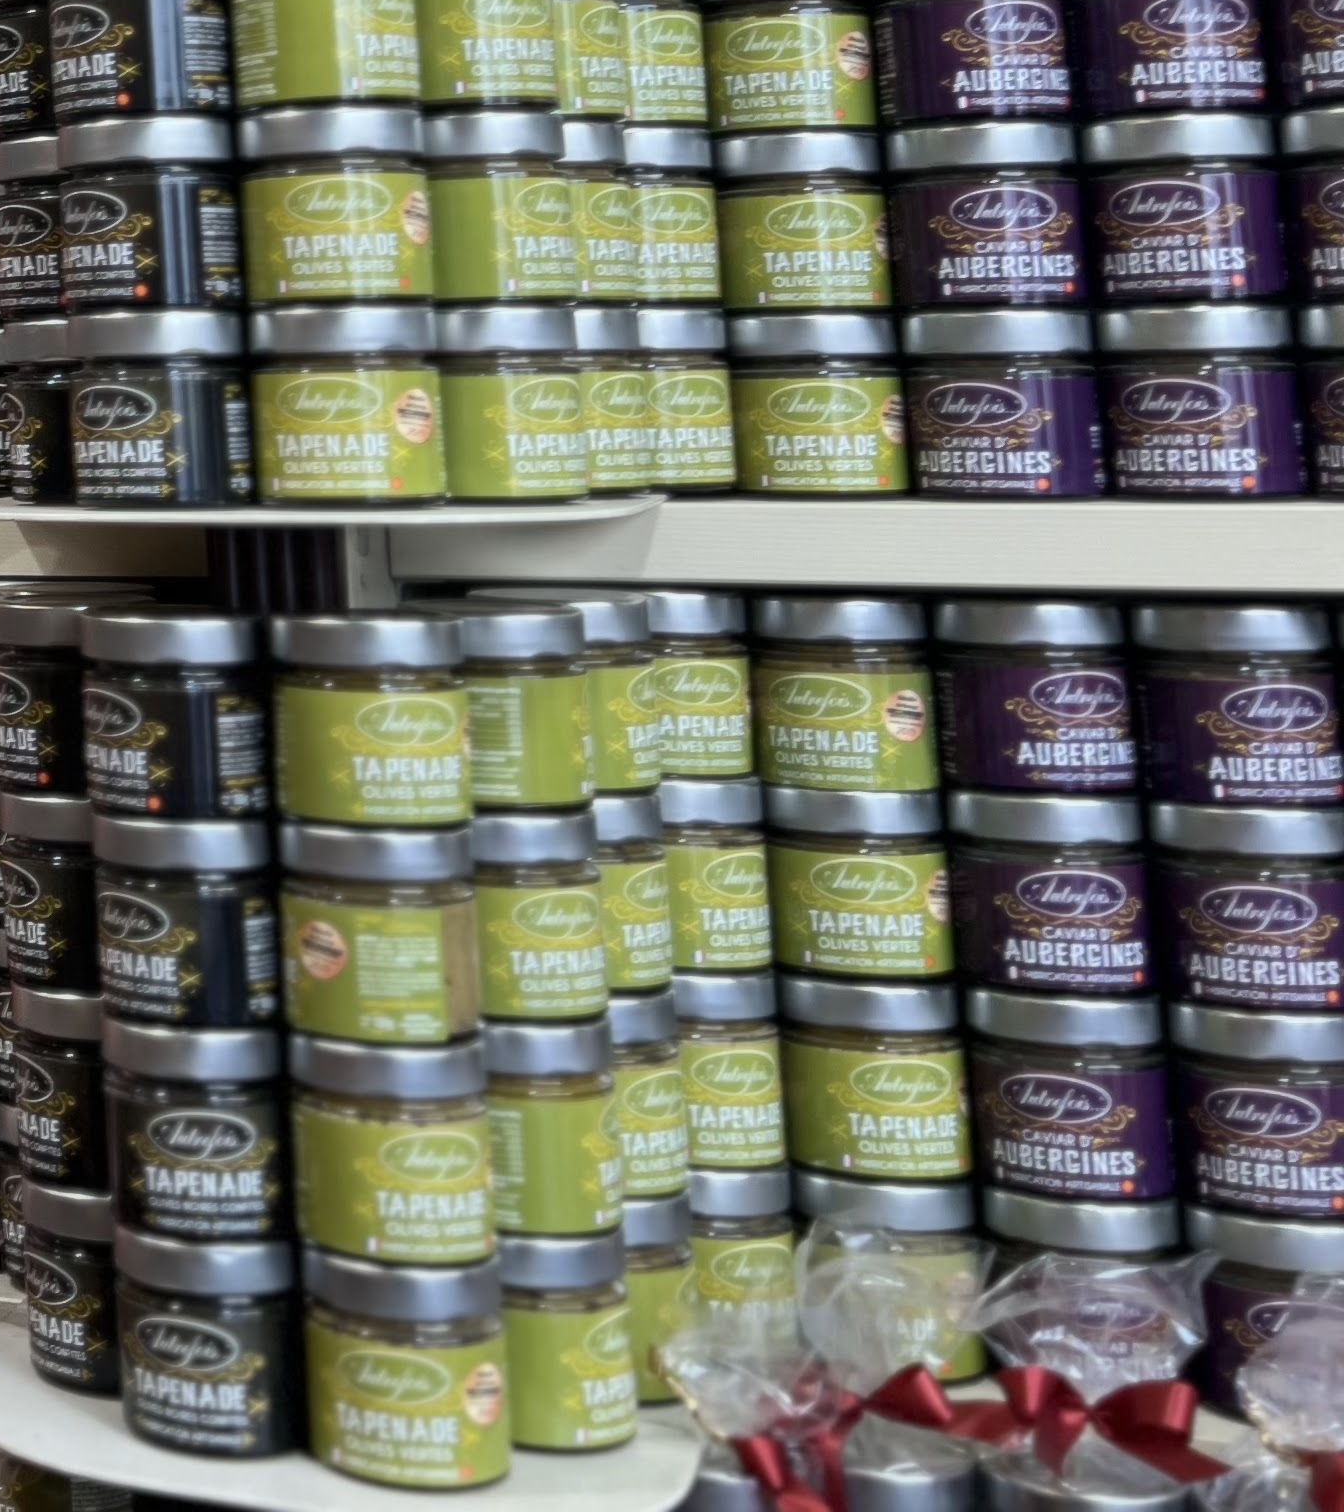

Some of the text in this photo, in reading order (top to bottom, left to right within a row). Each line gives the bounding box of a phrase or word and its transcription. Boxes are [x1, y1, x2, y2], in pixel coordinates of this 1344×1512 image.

[462, 39, 553, 62] TAPENADE
[724, 67, 832, 94] TAPENADE
[1130, 60, 1265, 87] AUBERGINES
[731, 90, 827, 110] OLIVES VERTES
[284, 233, 399, 258] TAPENADE
[973, 240, 1023, 255] CAVIAR
[291, 259, 395, 276] OLIVES VERTES
[764, 249, 871, 274] TAPENADE
[938, 254, 1075, 280] AUBERGINES
[1105, 247, 1244, 276] AUBERGINES
[772, 273, 869, 289] OLIVES VERTES
[277, 434, 389, 458] TAPENADE
[765, 433, 877, 458] TAPENADE
[1139, 436, 1189, 450] CAVIAR
[283, 460, 384, 474] OLIVES VERTES
[919, 448, 1052, 475] AUBERGINES
[1117, 447, 1257, 474] AUBERGINES
[768, 725, 879, 753] TAPENADE
[352, 755, 461, 782] TAPENADE
[776, 751, 874, 769] OLIVES VERTES
[362, 785, 409, 799] OLIVES
[809, 908, 924, 938] TAPENADE
[1041, 927, 1094, 940] CAVIAR
[817, 936, 921, 953] OLIVES VERTES
[1005, 939, 1144, 967] AUBERGINES
[1190, 953, 1339, 988] AUBERGINES
[848, 1112, 957, 1138] TAPENADE
[1022, 1129, 1076, 1146] CAVIAR
[858, 1140, 956, 1156] OLIVES VERTES
[993, 1138, 1136, 1175] AUBERGINES
[145, 1167, 263, 1198] TAPENADE
[1198, 1157, 1344, 1192] AUBERGINES
[378, 1192, 486, 1220] TAPENADE
[385, 1221, 483, 1237] OLIVES VERTES
[136, 1368, 246, 1411] TAPENADE
[336, 1403, 459, 1444] TAPENADE
